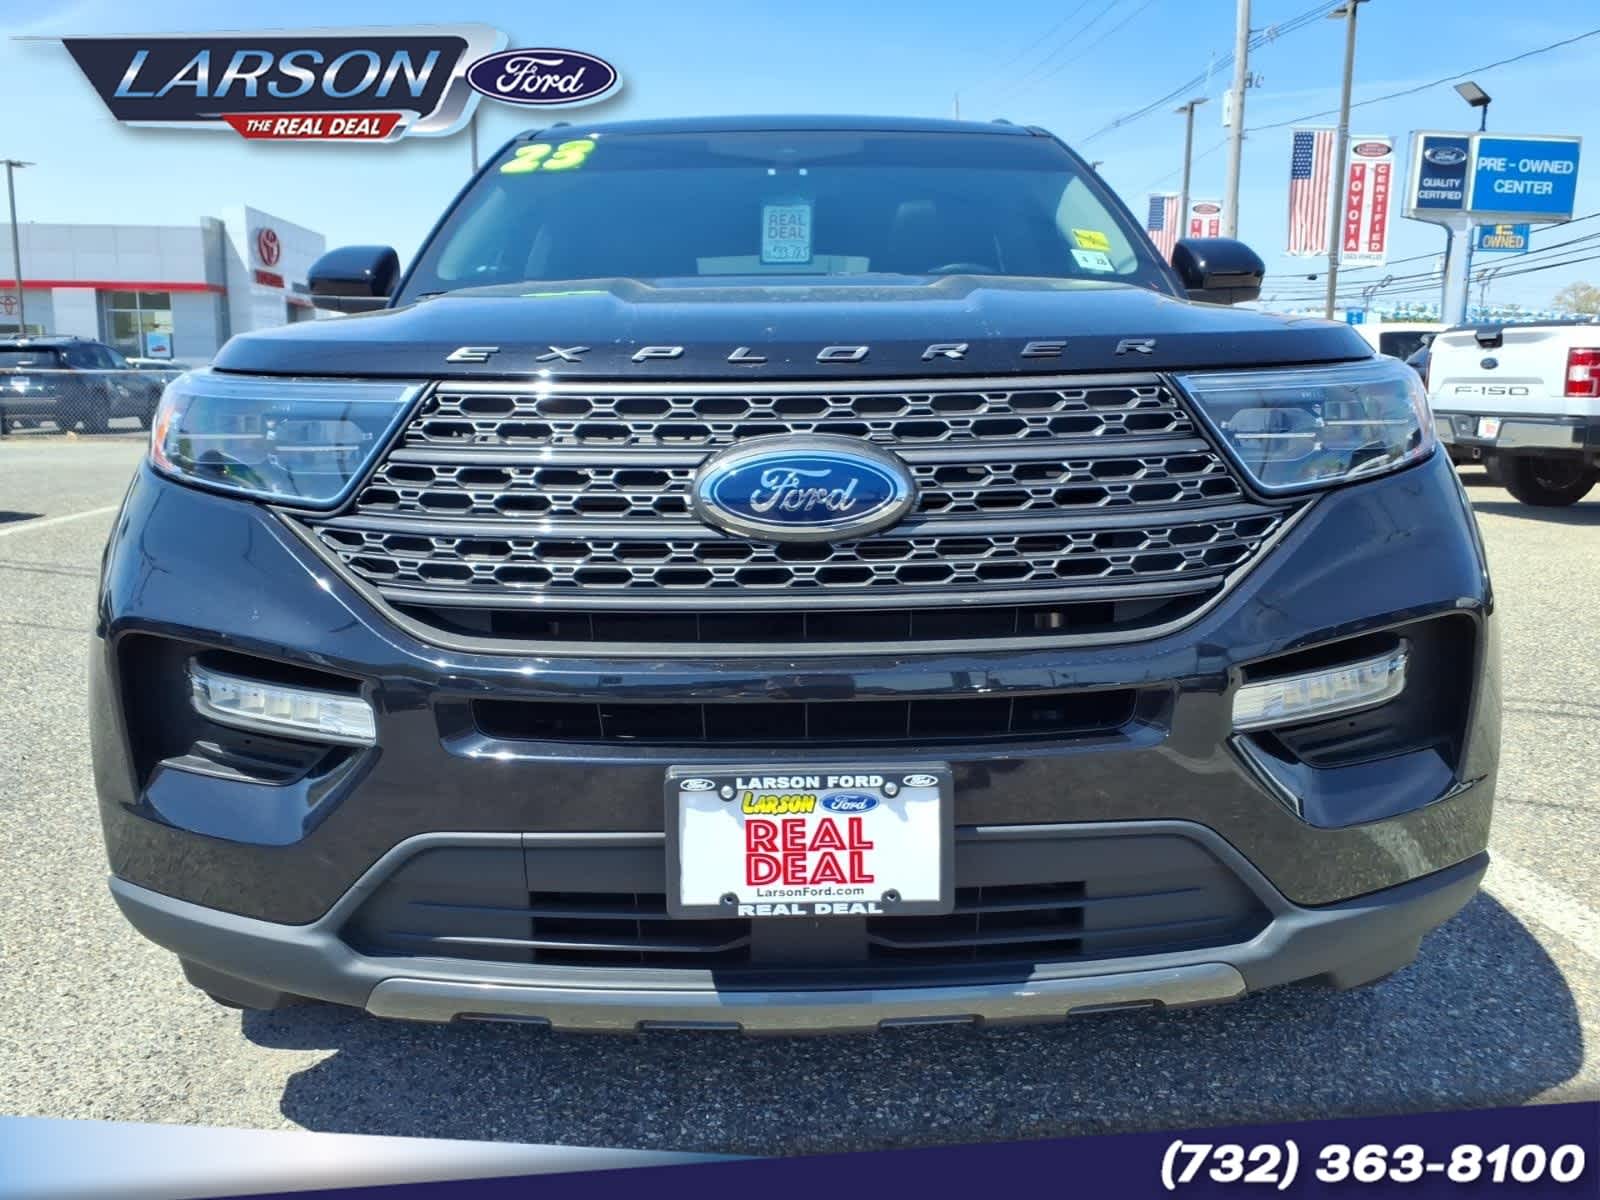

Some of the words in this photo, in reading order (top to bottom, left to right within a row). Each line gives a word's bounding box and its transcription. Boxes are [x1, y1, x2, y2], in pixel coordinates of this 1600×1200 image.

[1423, 178, 1461, 188] QUALITY
[1494, 179, 1553, 195] CENTER
[1418, 190, 1462, 200] CERTIFIED
[1347, 165, 1363, 250] TOYOTA
[1371, 165, 1388, 250] CERTIFIED
[768, 213, 807, 226] REAL
[768, 226, 807, 239] DEAL
[1483, 235, 1524, 249] OWNED
[446, 338, 1157, 363] EXPLORER
[1454, 386, 1529, 396] F-150
[751, 467, 858, 513] Ford
[736, 775, 820, 790] LARSON
[827, 775, 884, 789] FORD
[741, 792, 816, 815] LARSON
[831, 794, 868, 811] Ford
[744, 817, 873, 852] REAL
[746, 851, 874, 886] DEAL
[756, 886, 865, 898] LarsonFord.com
[738, 903, 806, 916] REAL
[815, 902, 884, 915] DEAL
